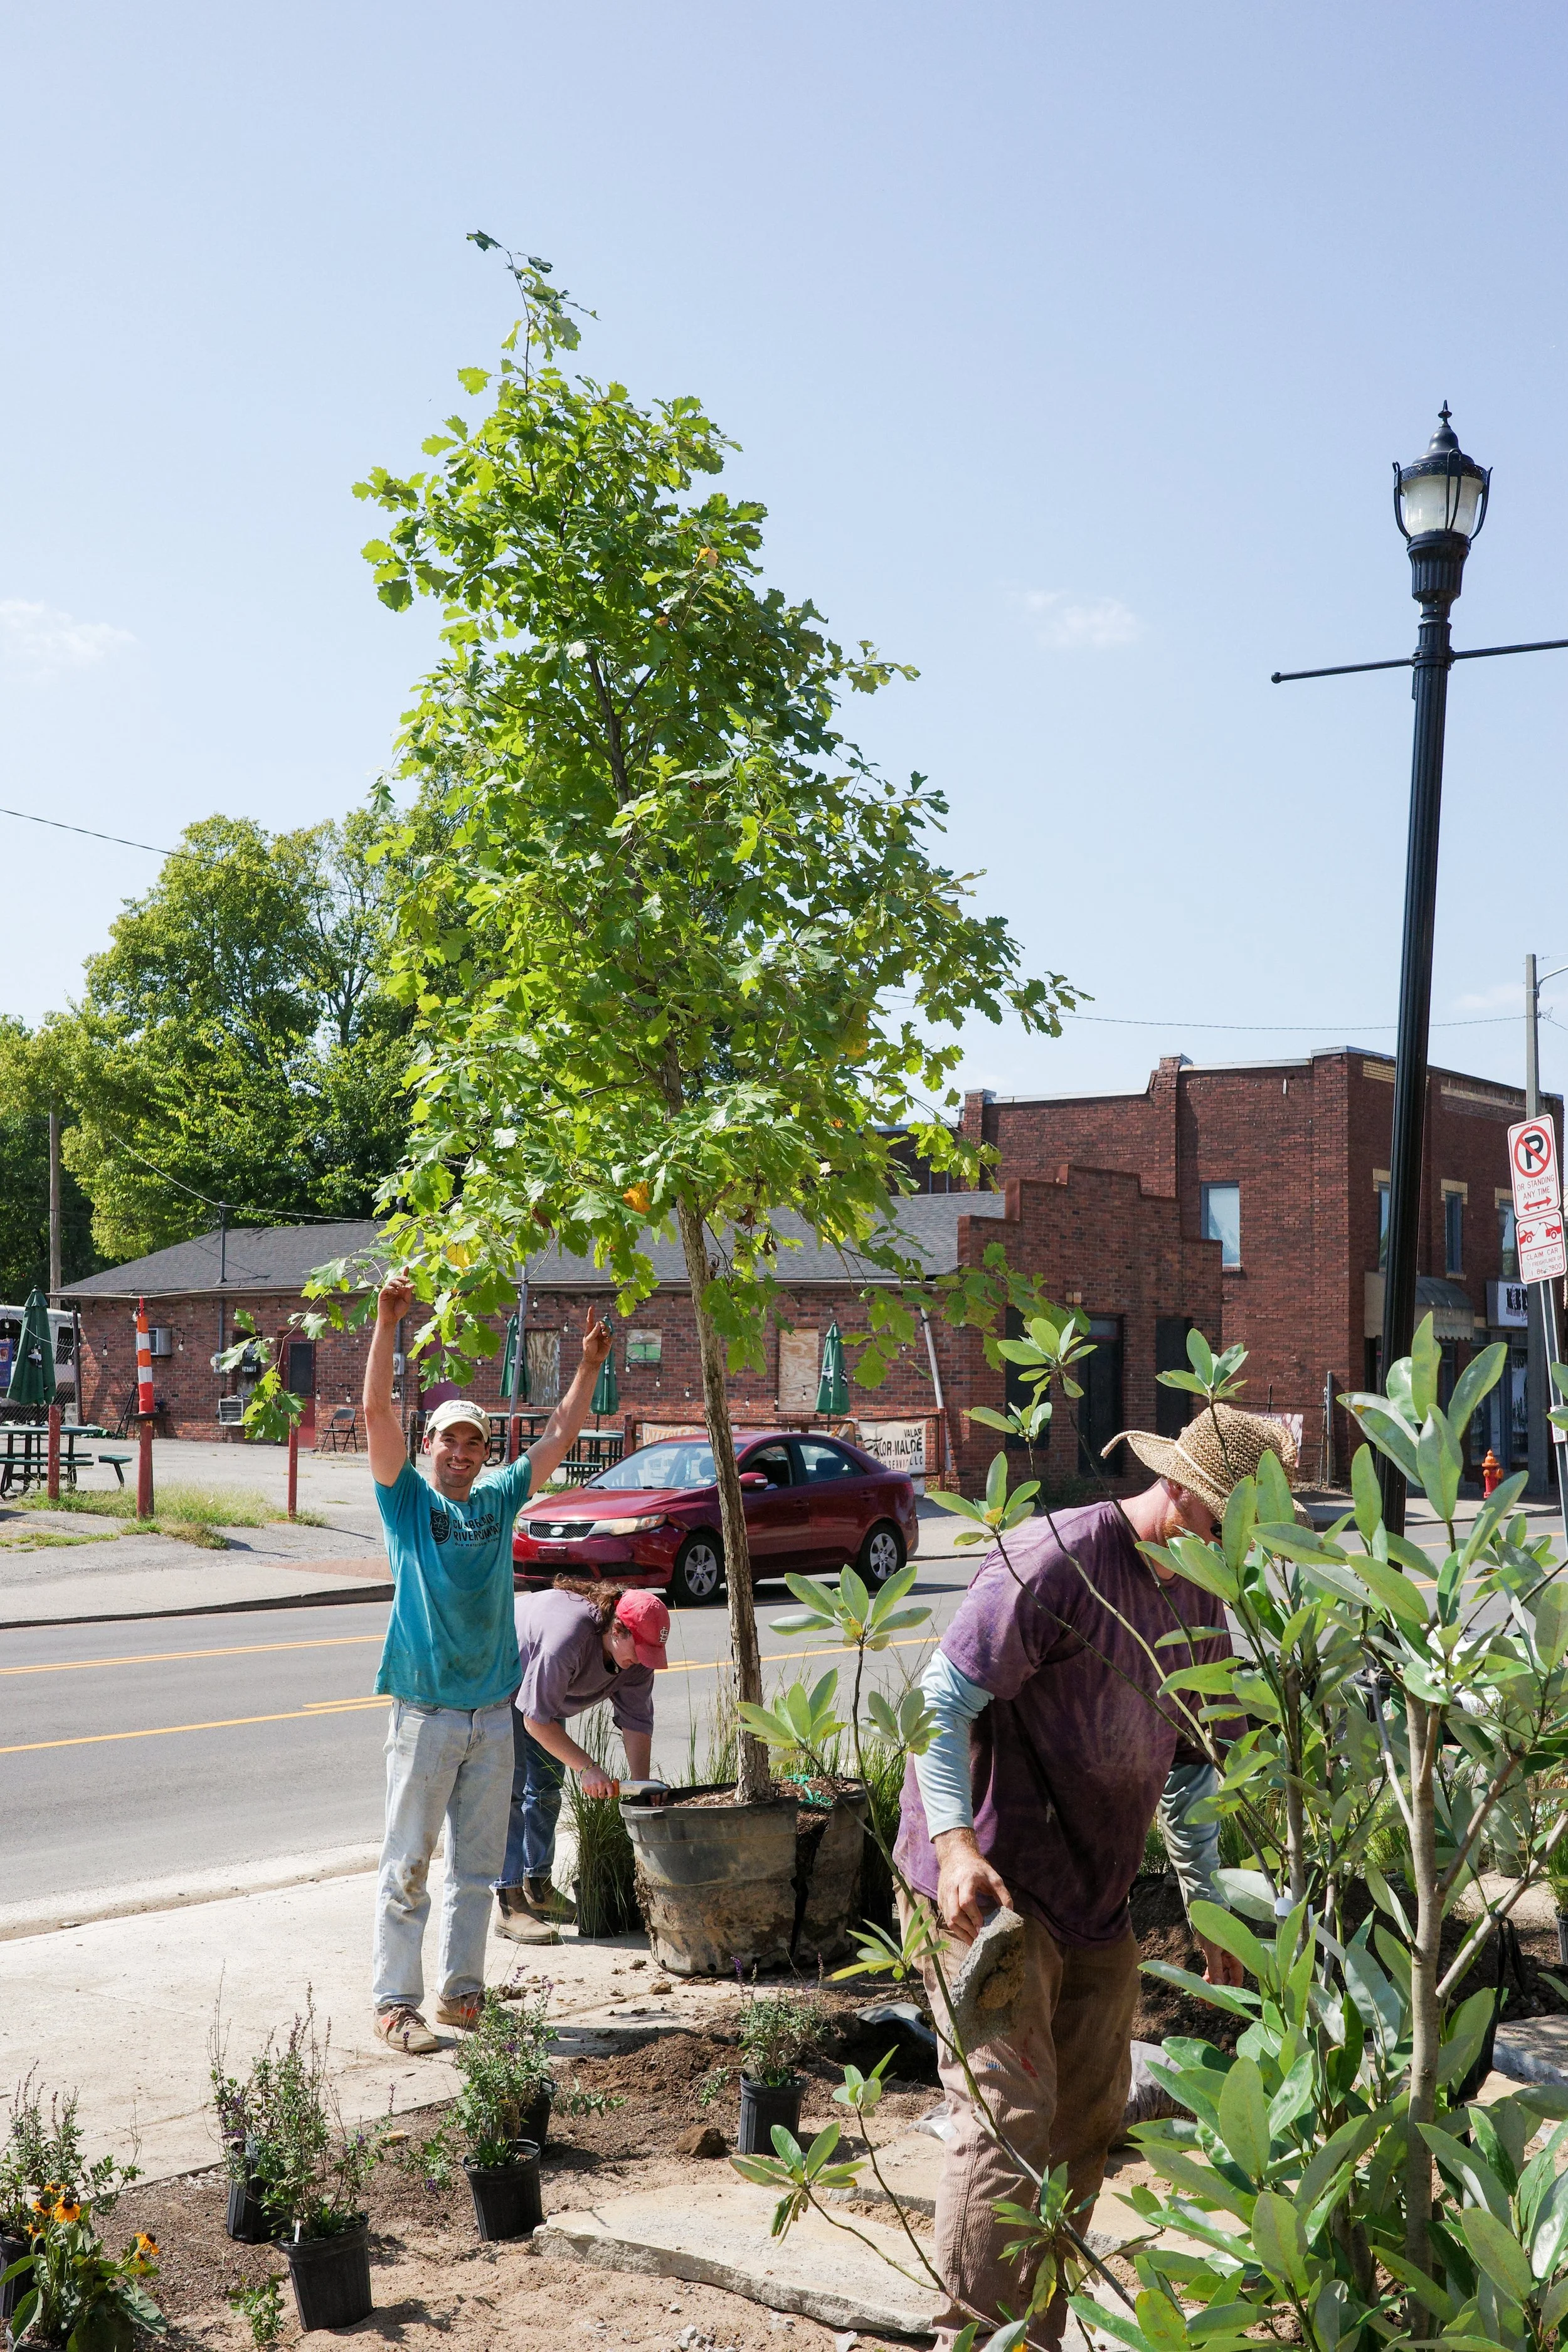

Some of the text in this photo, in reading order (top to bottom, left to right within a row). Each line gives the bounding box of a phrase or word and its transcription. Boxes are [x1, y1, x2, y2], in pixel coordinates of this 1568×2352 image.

[1517, 1174, 1555, 1192] OR STANDING
[1523, 1185, 1550, 1200] ANY TIME
[1526, 1247, 1559, 1261] CLAIM CAR
[1532, 1256, 1556, 1267] FREIGHTLINER
[1536, 1263, 1562, 1274] 86-7800
[909, 1456, 923, 1466] LLC
[453, 1530, 479, 1542] RIVER
